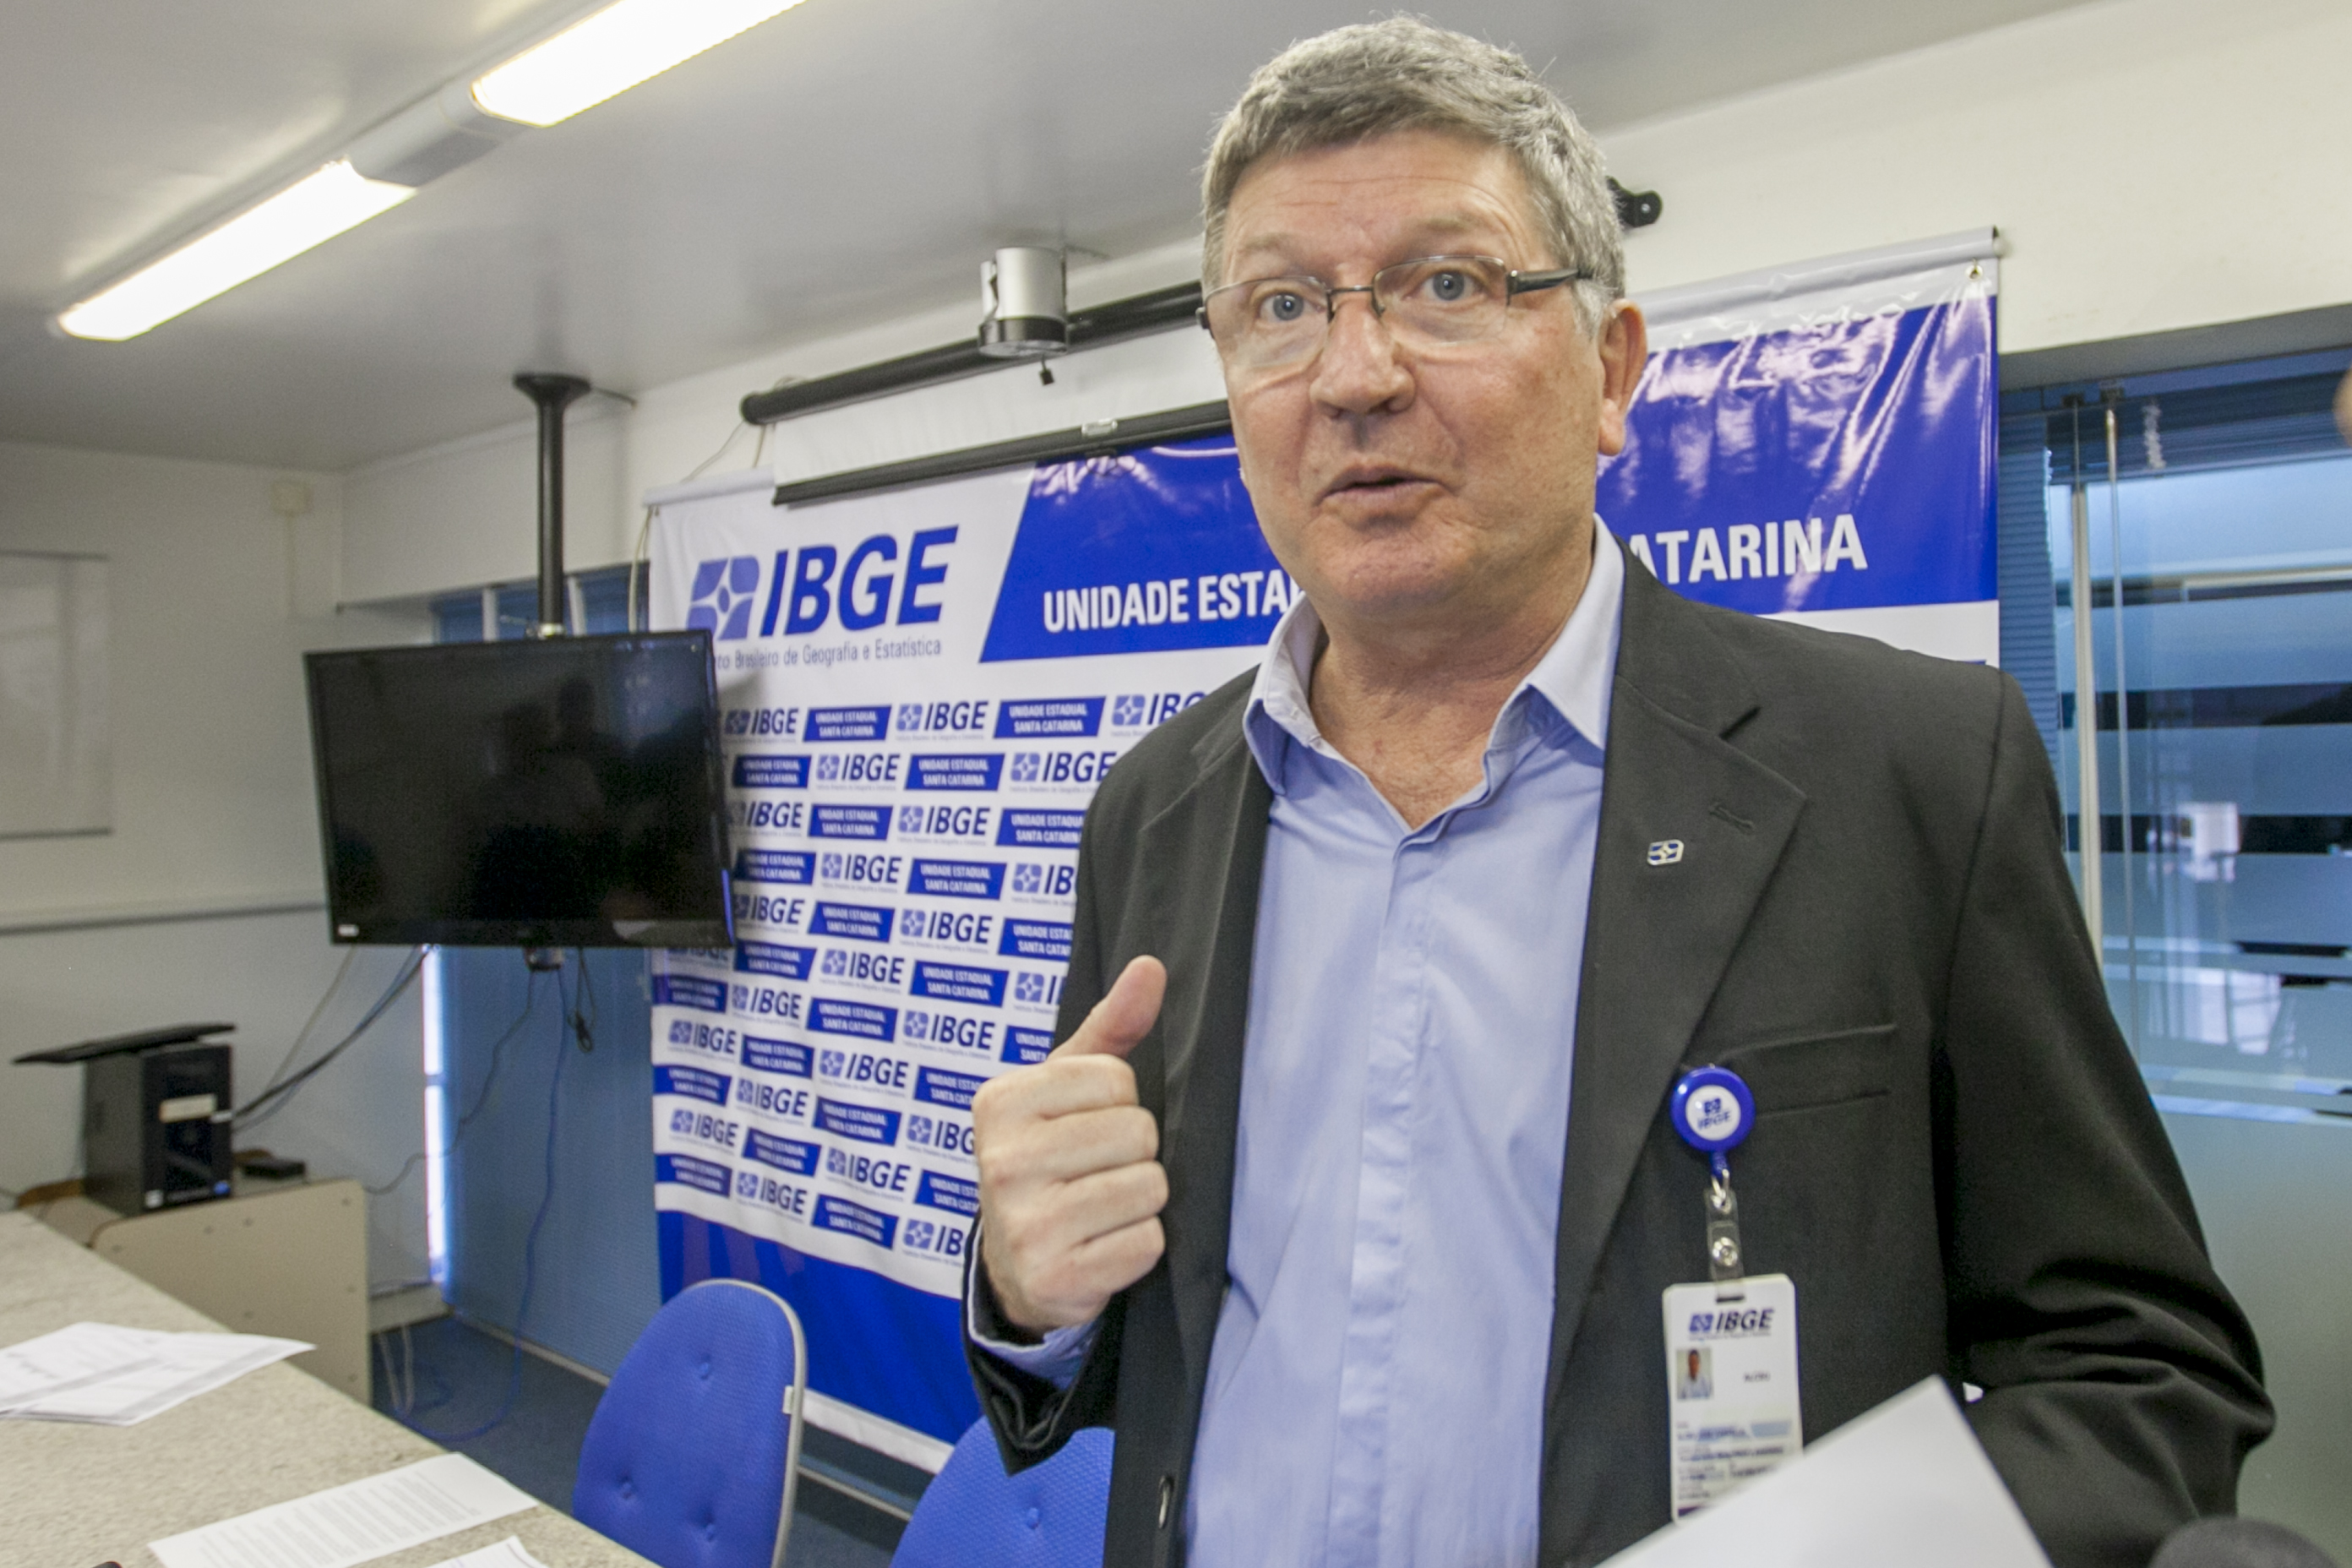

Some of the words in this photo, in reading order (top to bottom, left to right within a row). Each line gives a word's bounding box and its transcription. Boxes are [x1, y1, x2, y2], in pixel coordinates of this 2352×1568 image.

[760, 524, 959, 638] IBGE
[1043, 577, 1190, 633] UNIDADE
[1198, 569, 1299, 621] ESTA
[1629, 514, 1869, 585] ATARINA
[735, 649, 779, 668] Brasileiro
[784, 645, 798, 666] de
[803, 640, 858, 667] Geografia
[863, 648, 869, 660] e
[875, 634, 940, 659] Estatística
[750, 708, 799, 735] IBGE
[815, 712, 843, 724] UNIDADE
[845, 711, 877, 722] ESTADUAL
[924, 701, 988, 731] IBGE
[1009, 705, 1045, 717] UNIDADE
[1046, 703, 1087, 716] ESTADUAL
[1147, 691, 1205, 725] IB
[819, 727, 841, 738] SANTA
[841, 726, 874, 737] CATARINA
[1015, 721, 1041, 733] SANTA
[1043, 720, 1083, 732] CATARINA
[841, 754, 900, 781] IBGE
[918, 760, 950, 771] UNIDADE
[951, 760, 989, 771] ESTADUAL
[1042, 751, 1117, 782] IBGE
[923, 774, 946, 786] SANTA
[948, 775, 985, 787] CATARINA
[746, 801, 803, 828] IBGE
[817, 808, 843, 820] UNIDADE
[845, 809, 879, 822] ESTADUAL
[925, 807, 990, 836] IBGE
[1048, 815, 1083, 827] ESTADUA
[822, 823, 842, 834] SANTA
[843, 824, 875, 836] CATARINA
[845, 855, 901, 883] IBGE
[920, 864, 952, 877] UNIDADE
[953, 866, 990, 879] ESTADUAL
[1044, 865, 1074, 895] IB
[925, 879, 948, 891] SANTA
[950, 881, 986, 894] CATARINA
[750, 896, 804, 924] IBGE
[822, 906, 848, 919] UNIDADE
[849, 909, 881, 923] ESTADUAL
[826, 921, 846, 932] SANTA
[847, 923, 879, 936] CATARINA
[928, 911, 993, 944] IBGE
[849, 951, 904, 984] IBGE
[923, 966, 954, 979] UNIDADE
[955, 969, 994, 986] ESTADUAL
[751, 988, 803, 1019] IBGE
[928, 982, 950, 994] SANTA
[952, 984, 990, 1000] CATARINA
[819, 1003, 851, 1016] UNIDADE
[852, 1007, 885, 1022] ESTADUAL
[694, 1023, 737, 1054] IBGE
[822, 1019, 847, 1030] SANTA
[848, 1021, 883, 1035] CATARINA
[930, 1014, 995, 1049] IBGE
[847, 1053, 908, 1088] IBGE
[754, 1083, 808, 1116] IBGE
[694, 1113, 738, 1147] IBGE
[934, 1120, 975, 1155] IBG
[848, 1154, 911, 1191] IBGE
[760, 1177, 807, 1215] IBGE
[959, 1197, 979, 1211] CATA
[934, 1225, 964, 1256] IB
[1716, 1309, 1776, 1332] IBGE
